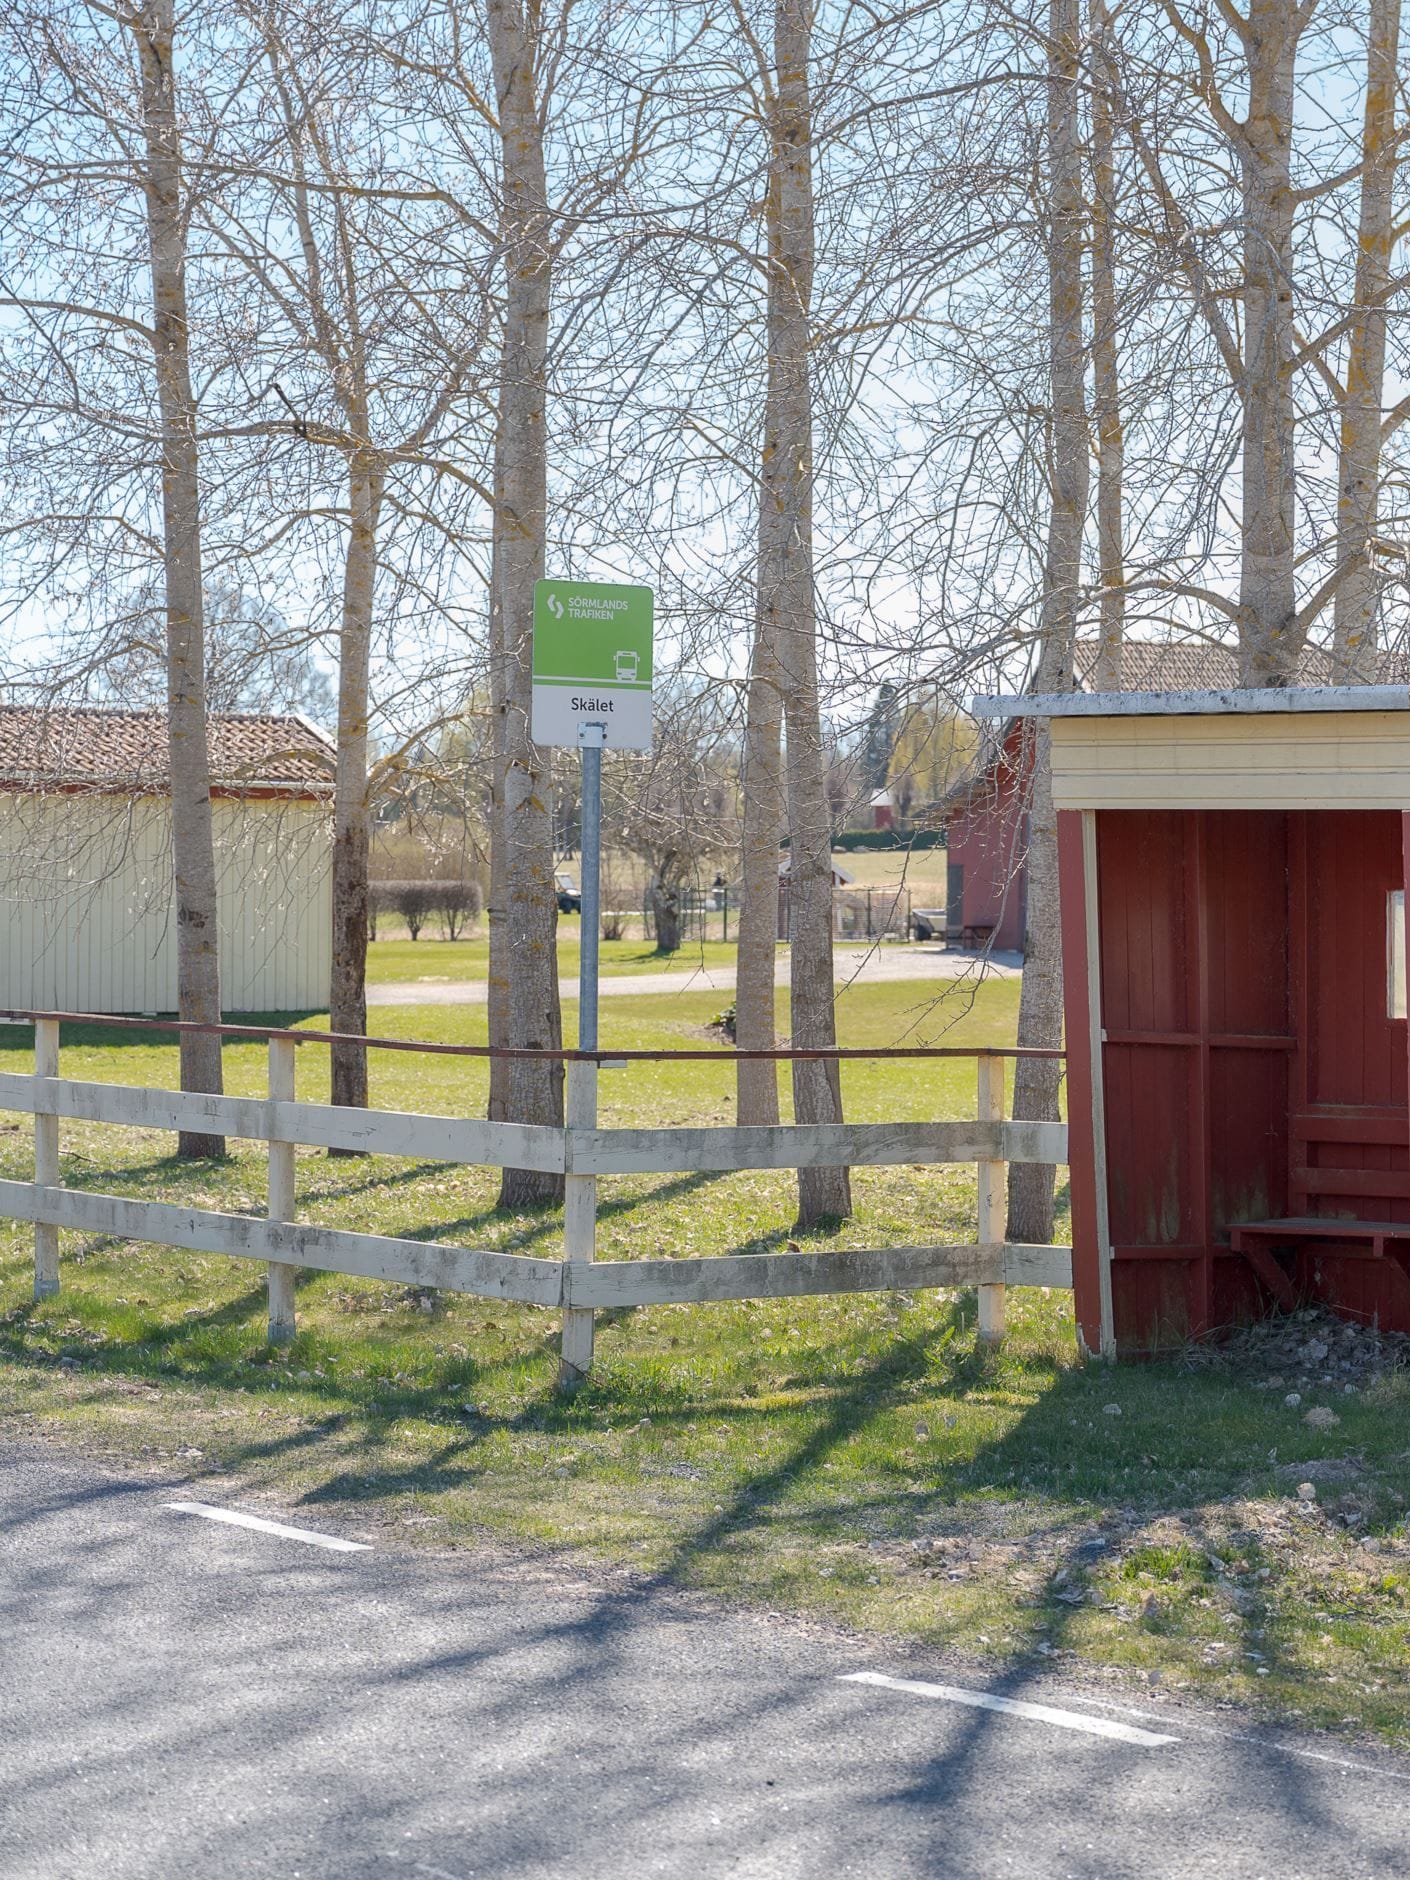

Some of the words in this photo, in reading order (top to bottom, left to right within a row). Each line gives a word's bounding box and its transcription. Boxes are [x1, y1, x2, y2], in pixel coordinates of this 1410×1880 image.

[568, 596, 629, 610] SÖRMLANDS
[568, 608, 614, 620] TRAFIKEN
[571, 697, 614, 712] Skälet
